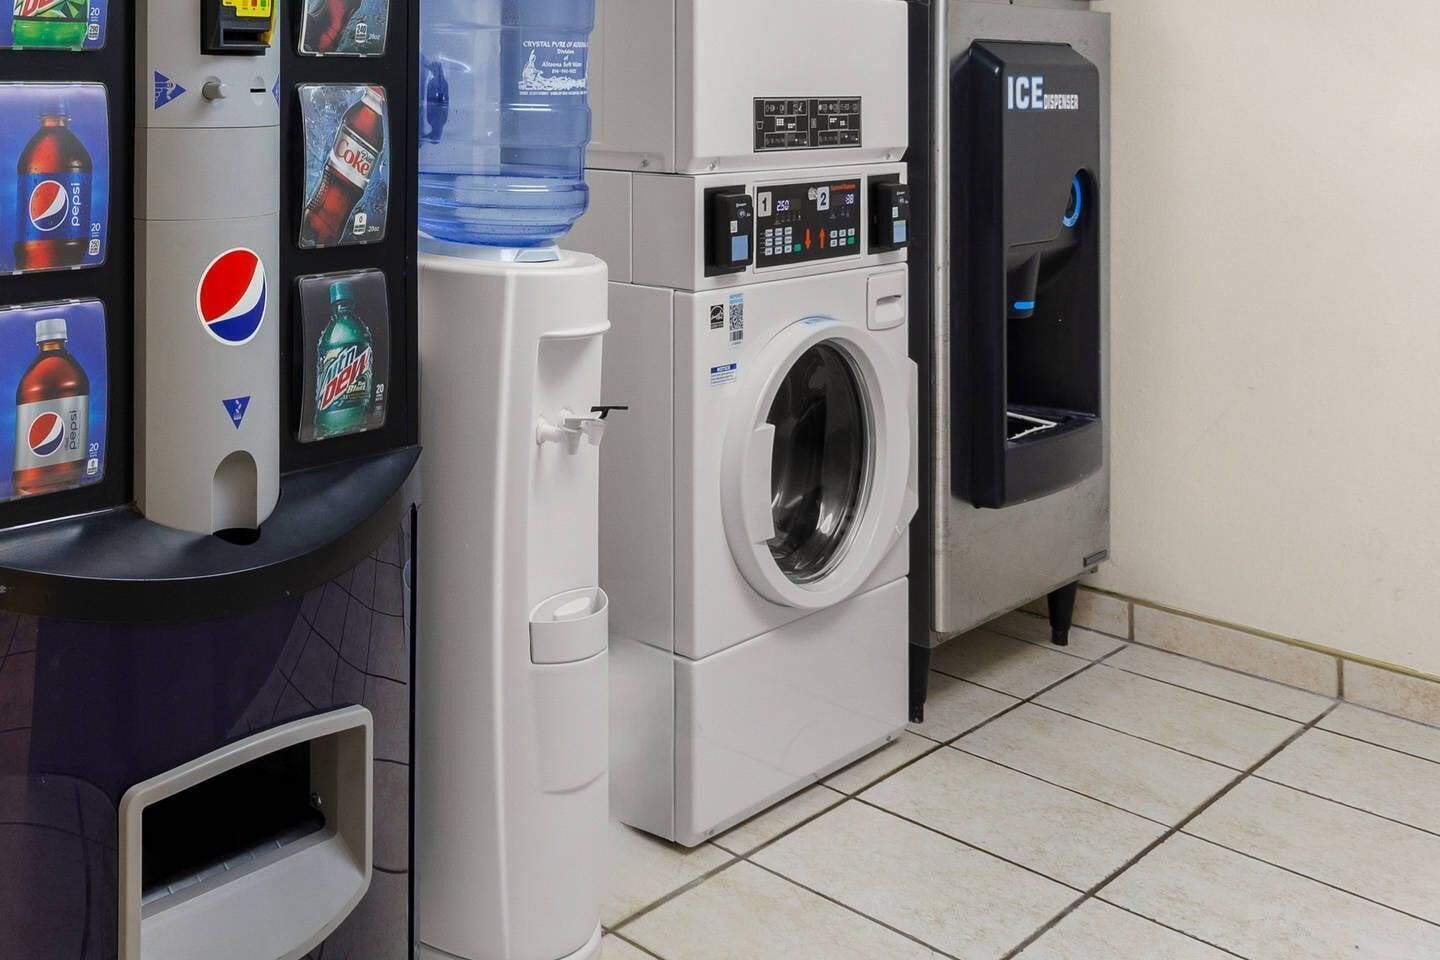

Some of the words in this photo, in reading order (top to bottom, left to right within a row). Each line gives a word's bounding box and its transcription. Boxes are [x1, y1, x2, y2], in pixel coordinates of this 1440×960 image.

[90, 7, 100, 16] 20
[357, 25, 367, 34] 240
[523, 40, 550, 48] CRYSTAL
[1007, 76, 1043, 110] ICE
[1044, 93, 1079, 110] DISPENSER
[336, 139, 370, 176] Coke
[71, 182, 80, 227] pepsi
[761, 196, 768, 212] 1
[820, 191, 827, 207] 2
[776, 200, 790, 211] 250
[90, 223, 101, 232] 20
[376, 384, 384, 393] 20
[69, 410, 79, 451] pepsi
[89, 442, 99, 452] 20
